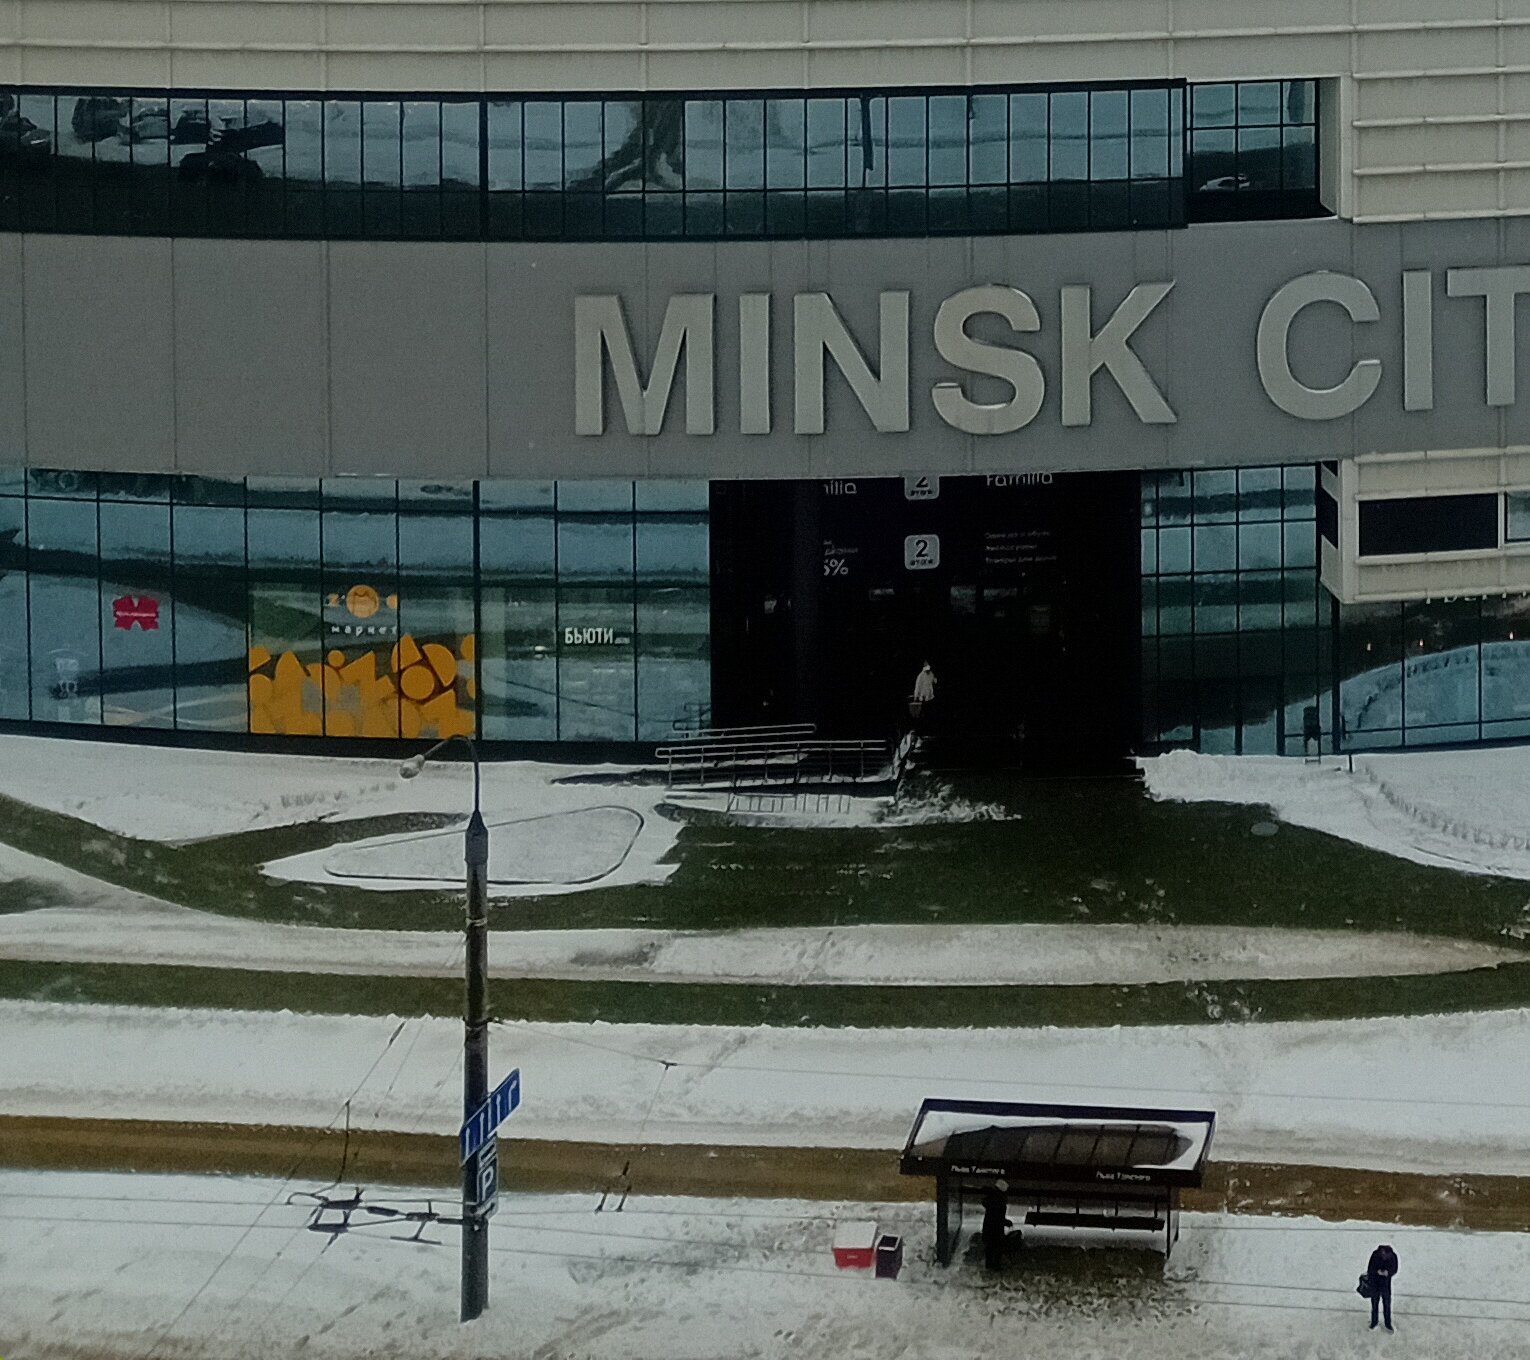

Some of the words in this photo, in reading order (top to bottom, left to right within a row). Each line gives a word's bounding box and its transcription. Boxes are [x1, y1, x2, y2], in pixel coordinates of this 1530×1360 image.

[574, 280, 1178, 437] MINSK
[915, 539, 929, 558] 2
[564, 626, 614, 645] БЬЮТИ
